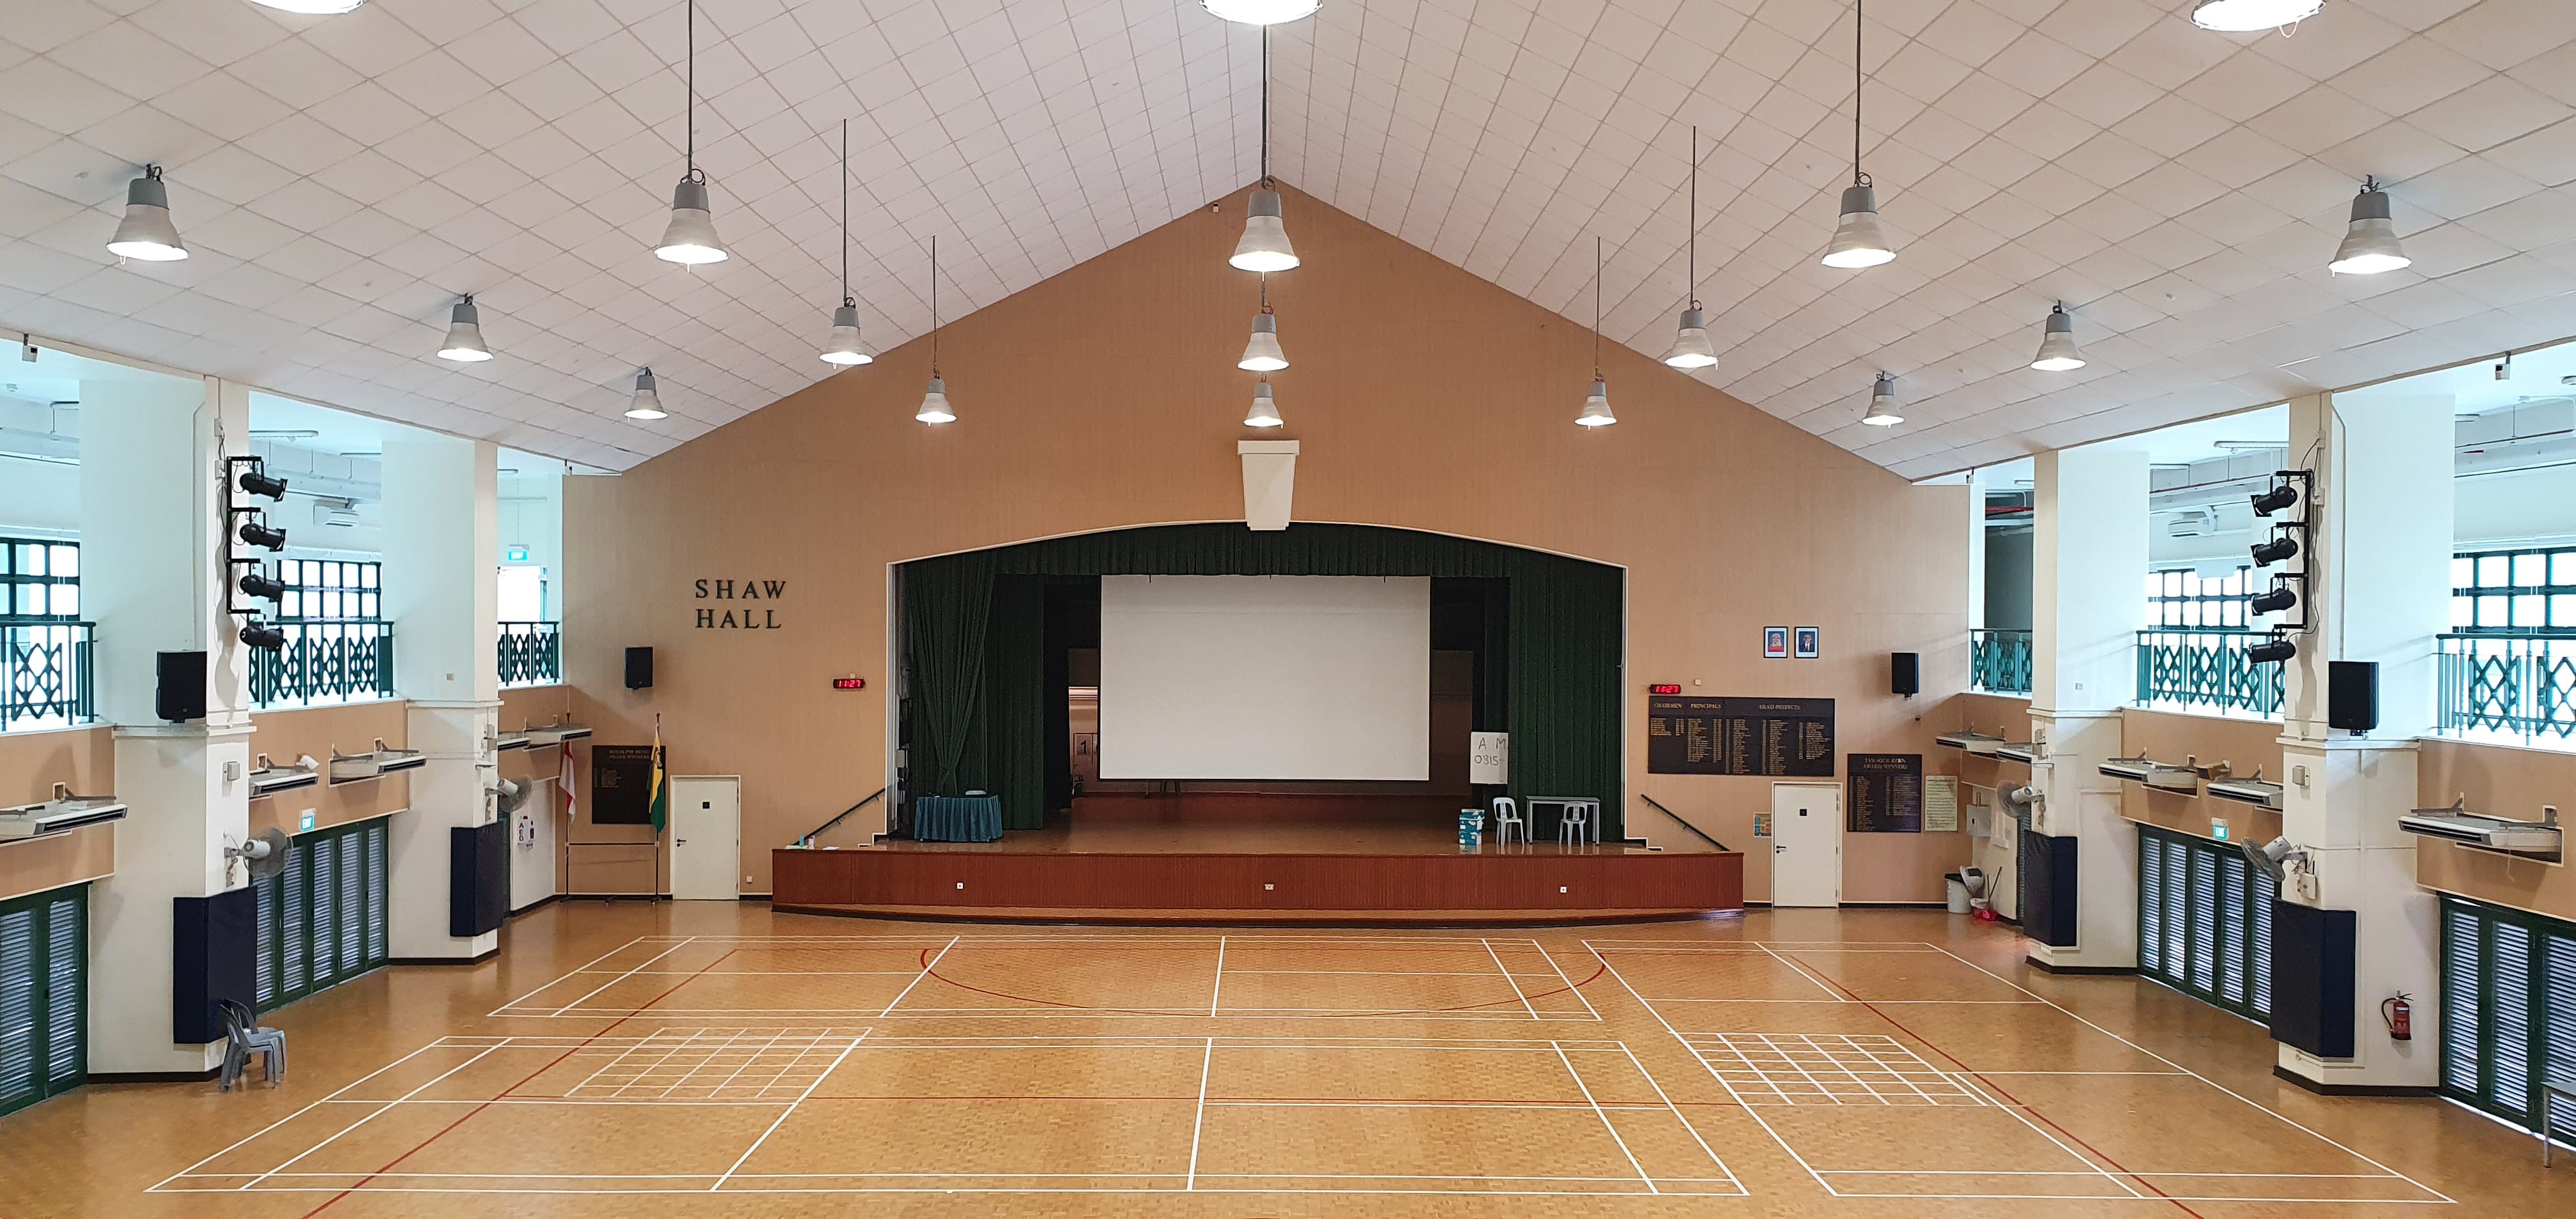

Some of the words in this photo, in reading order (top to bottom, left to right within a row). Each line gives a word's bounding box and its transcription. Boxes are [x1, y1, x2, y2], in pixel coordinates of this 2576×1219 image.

[695, 579, 786, 599] SHAW
[695, 609, 782, 629] HALL
[1080, 740, 1087, 755] 1
